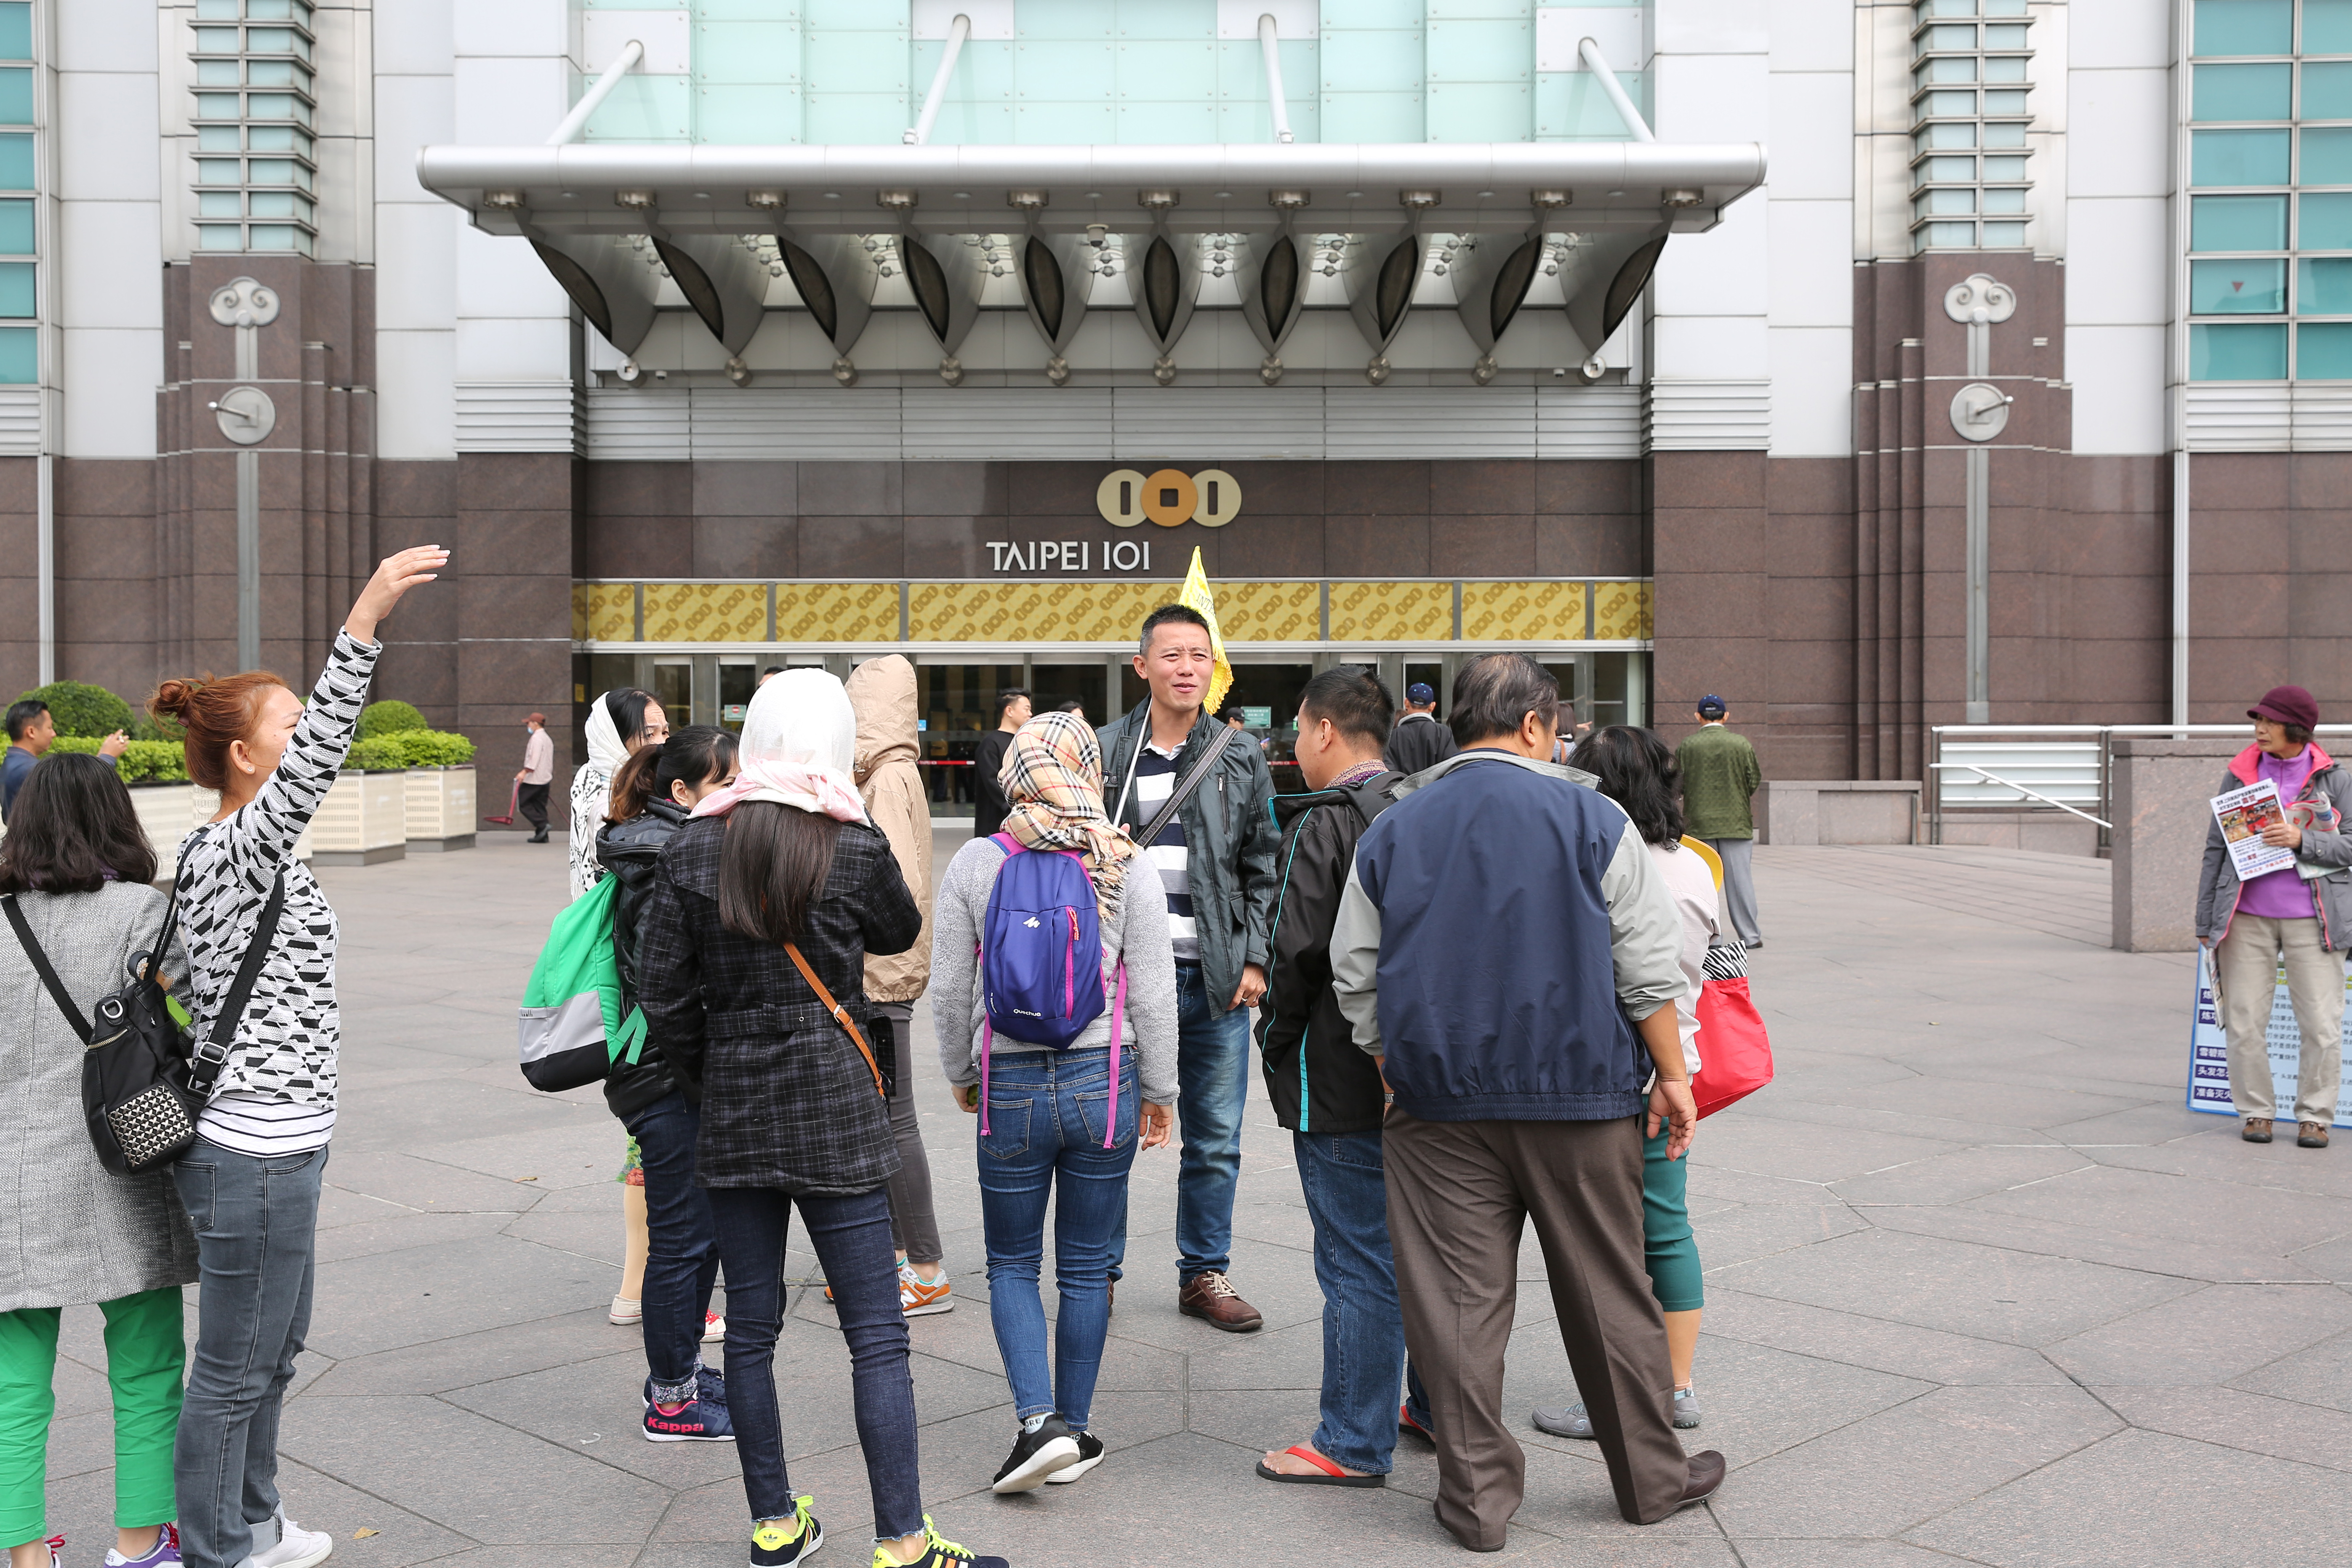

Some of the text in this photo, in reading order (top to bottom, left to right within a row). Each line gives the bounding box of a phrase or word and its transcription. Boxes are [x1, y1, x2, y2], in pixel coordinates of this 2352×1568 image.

[986, 541, 1089, 571] TAIPEI
[1013, 1009, 1041, 1017] Quechua
[647, 1417, 704, 1433] Kappa
